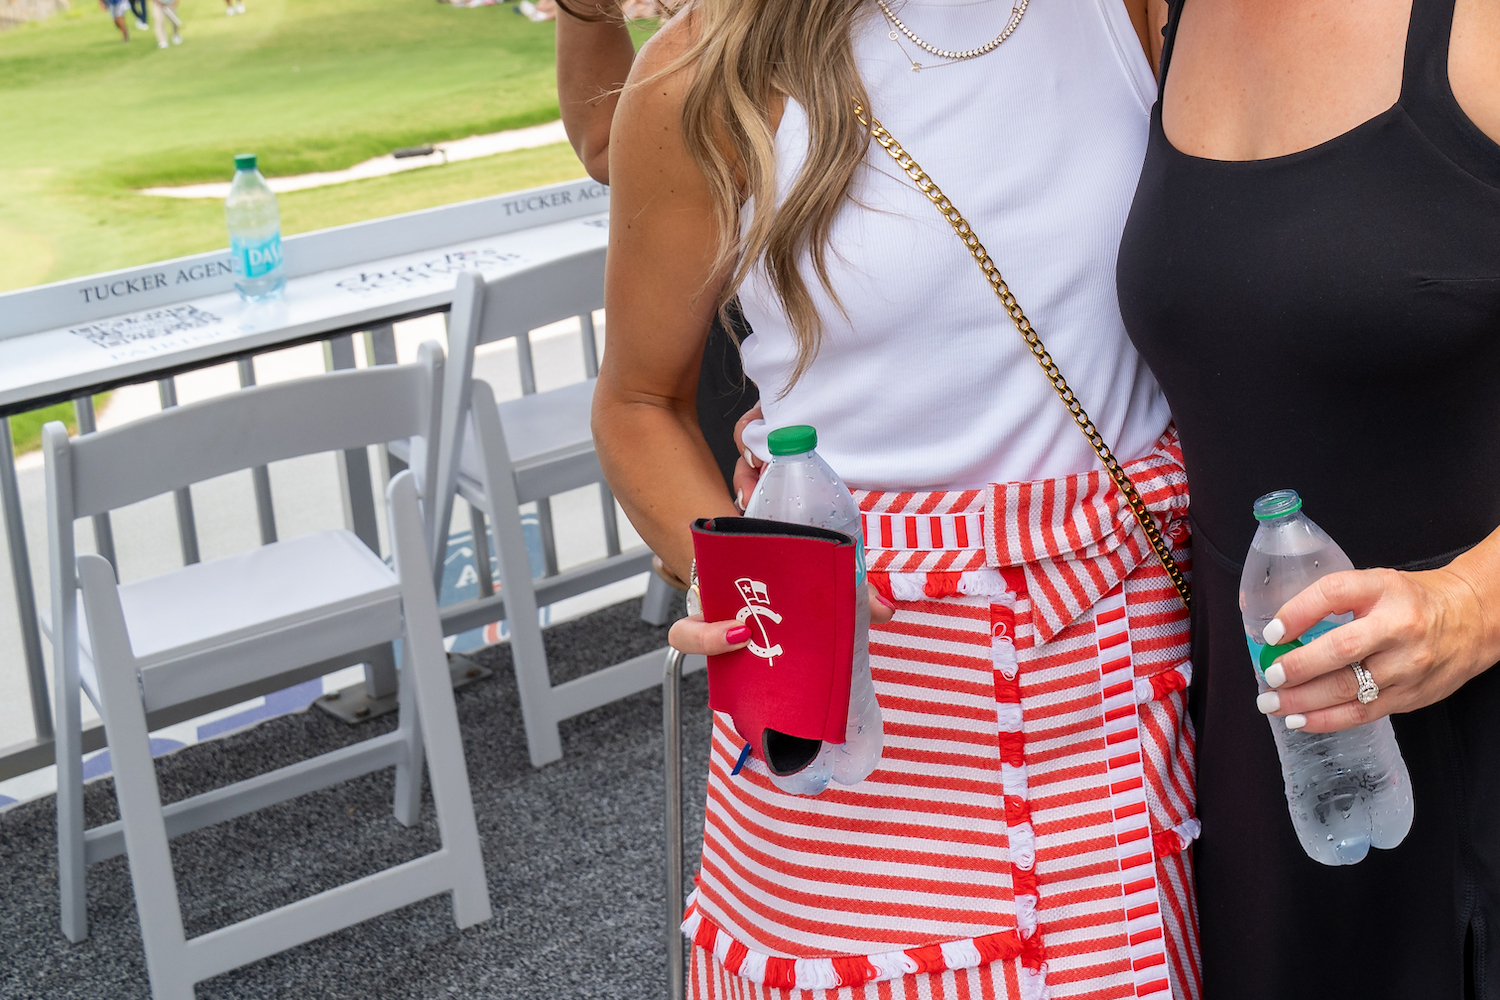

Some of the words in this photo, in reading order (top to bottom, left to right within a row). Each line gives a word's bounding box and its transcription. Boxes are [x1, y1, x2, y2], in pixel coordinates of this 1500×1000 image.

[501, 190, 573, 216] TUCKER
[577, 184, 610, 202] AGE
[79, 272, 168, 303] TUCKER
[175, 259, 233, 285] AGEN
